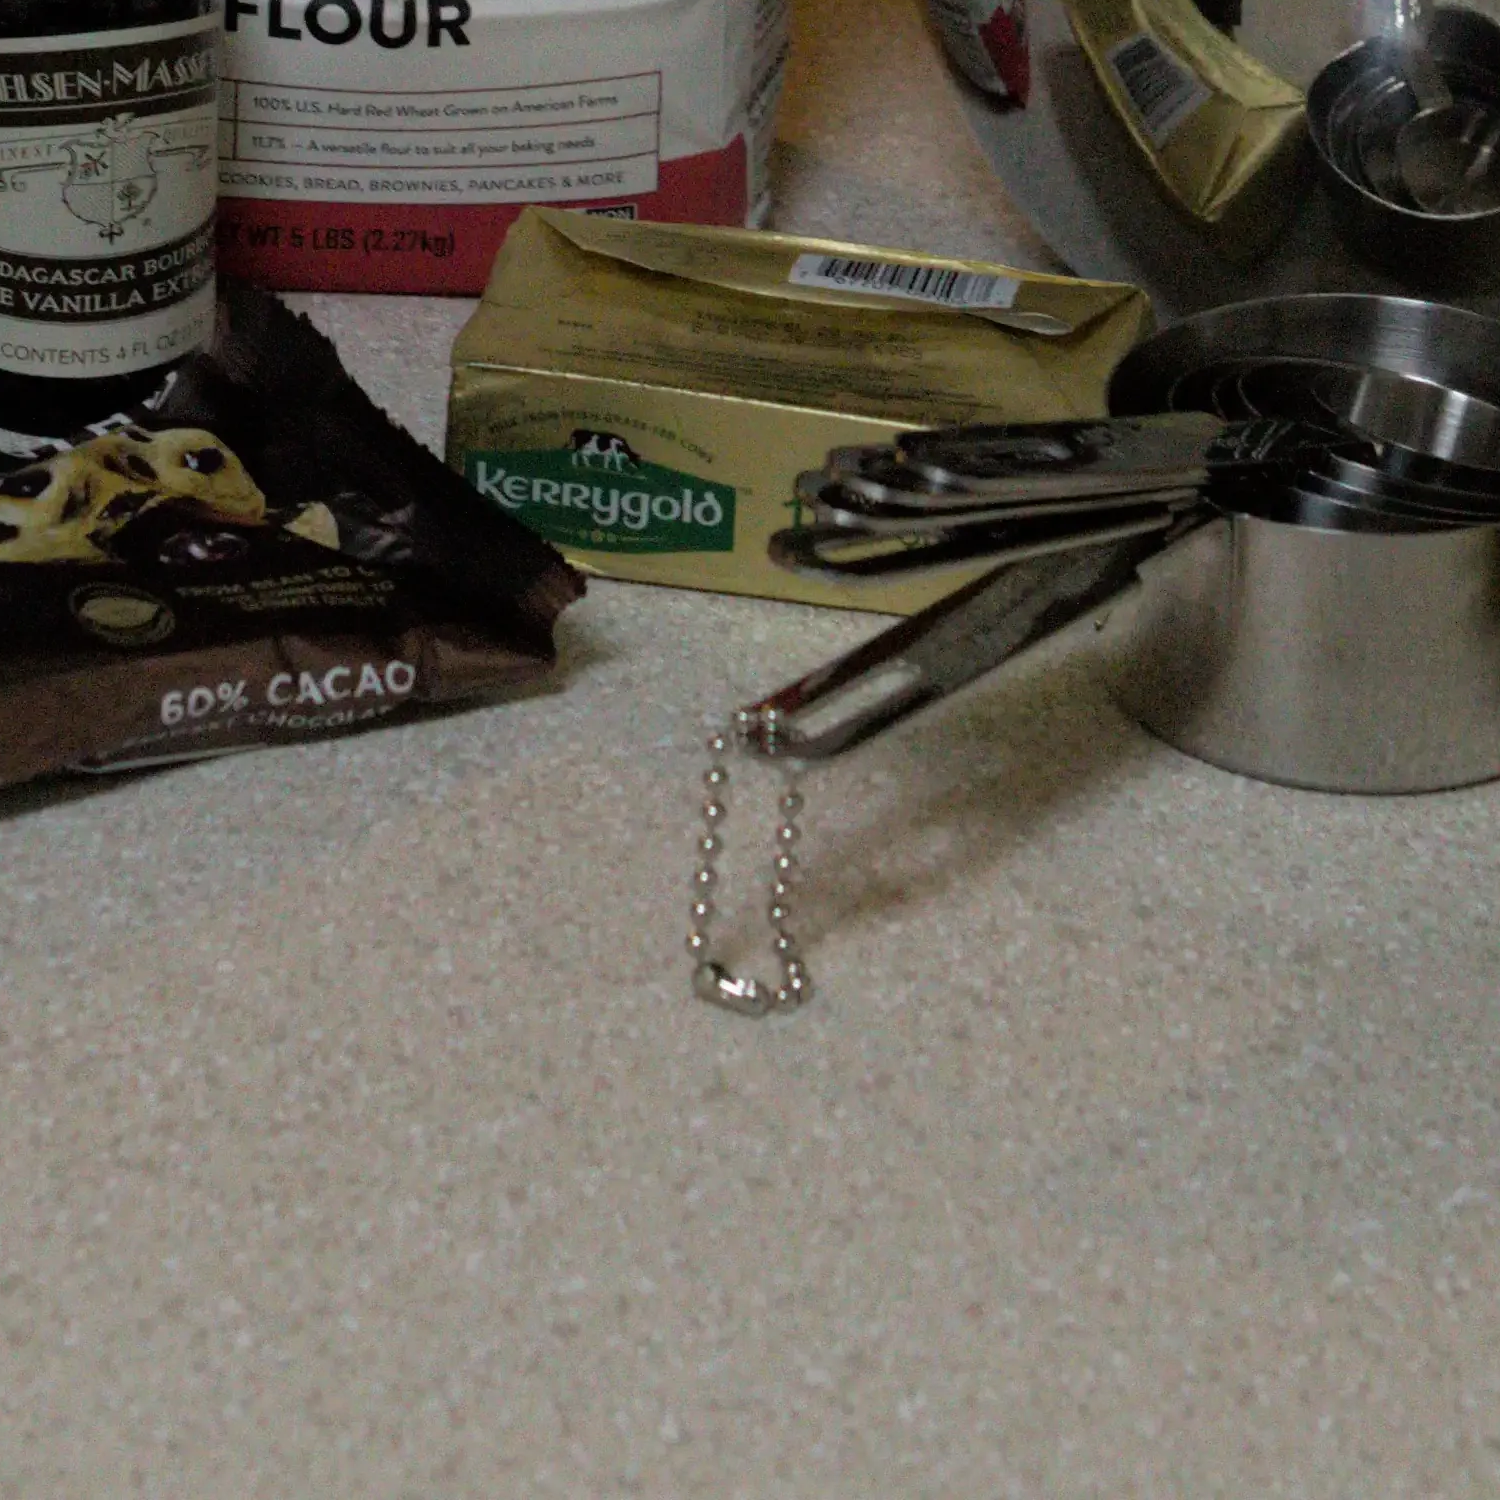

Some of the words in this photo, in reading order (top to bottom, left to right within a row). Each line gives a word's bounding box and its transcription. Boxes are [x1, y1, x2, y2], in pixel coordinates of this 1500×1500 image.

[252, 95, 292, 113] 100%
[295, 98, 323, 114] U.S.
[327, 101, 363, 116] Hard
[365, 102, 393, 117] Red
[395, 103, 440, 118] Wheat
[442, 102, 489, 118] Grown
[513, 99, 575, 115] American
[578, 94, 620, 109] Farms
[510, 138, 555, 157] baking
[302, 176, 366, 192] BREAD,
[368, 177, 465, 194] BROWNIES,
[468, 174, 557, 193] PANCAKES
[561, 176, 573, 189] &
[575, 170, 626, 187] MORE
[247, 225, 283, 248] WT
[290, 227, 304, 248] 5
[312, 227, 356, 251] LBS
[362, 228, 456, 257] (2.27kg)
[22, 288, 147, 315] VANILLA
[115, 340, 127, 361] 4
[131, 337, 150, 357] FL
[475, 460, 724, 531] Kerrygold
[159, 678, 250, 728] 60%
[266, 658, 418, 709] CACAO
